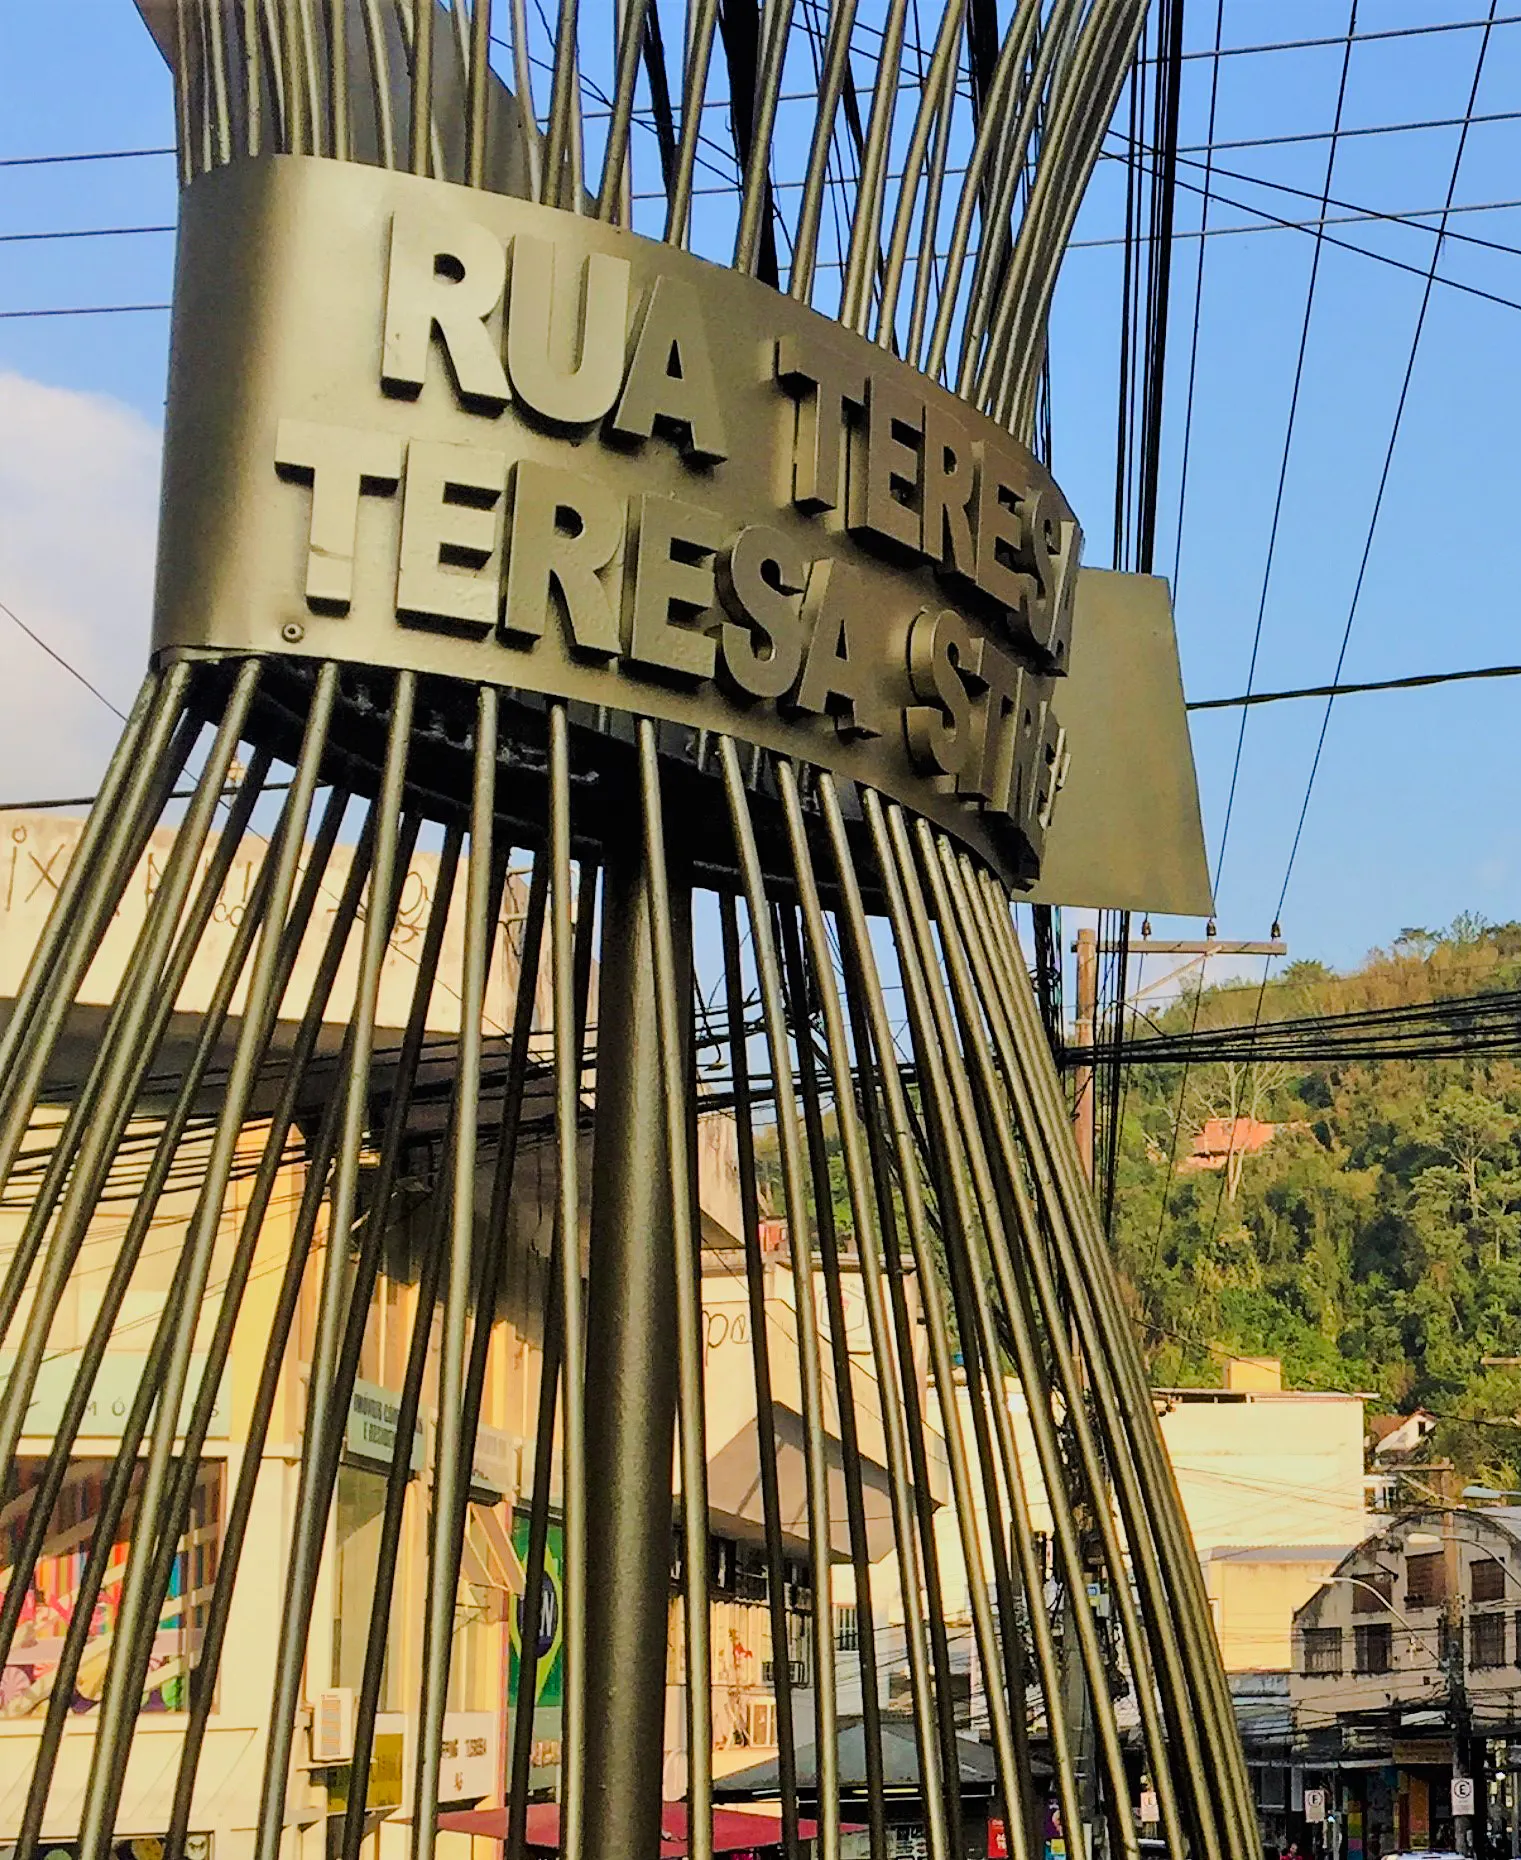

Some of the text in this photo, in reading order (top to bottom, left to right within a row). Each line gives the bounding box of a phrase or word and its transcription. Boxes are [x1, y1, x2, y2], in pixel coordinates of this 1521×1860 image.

[275, 418, 883, 740] TERESA
[381, 209, 1083, 678] RUA TERESA
[1459, 1784, 1466, 1796] E
